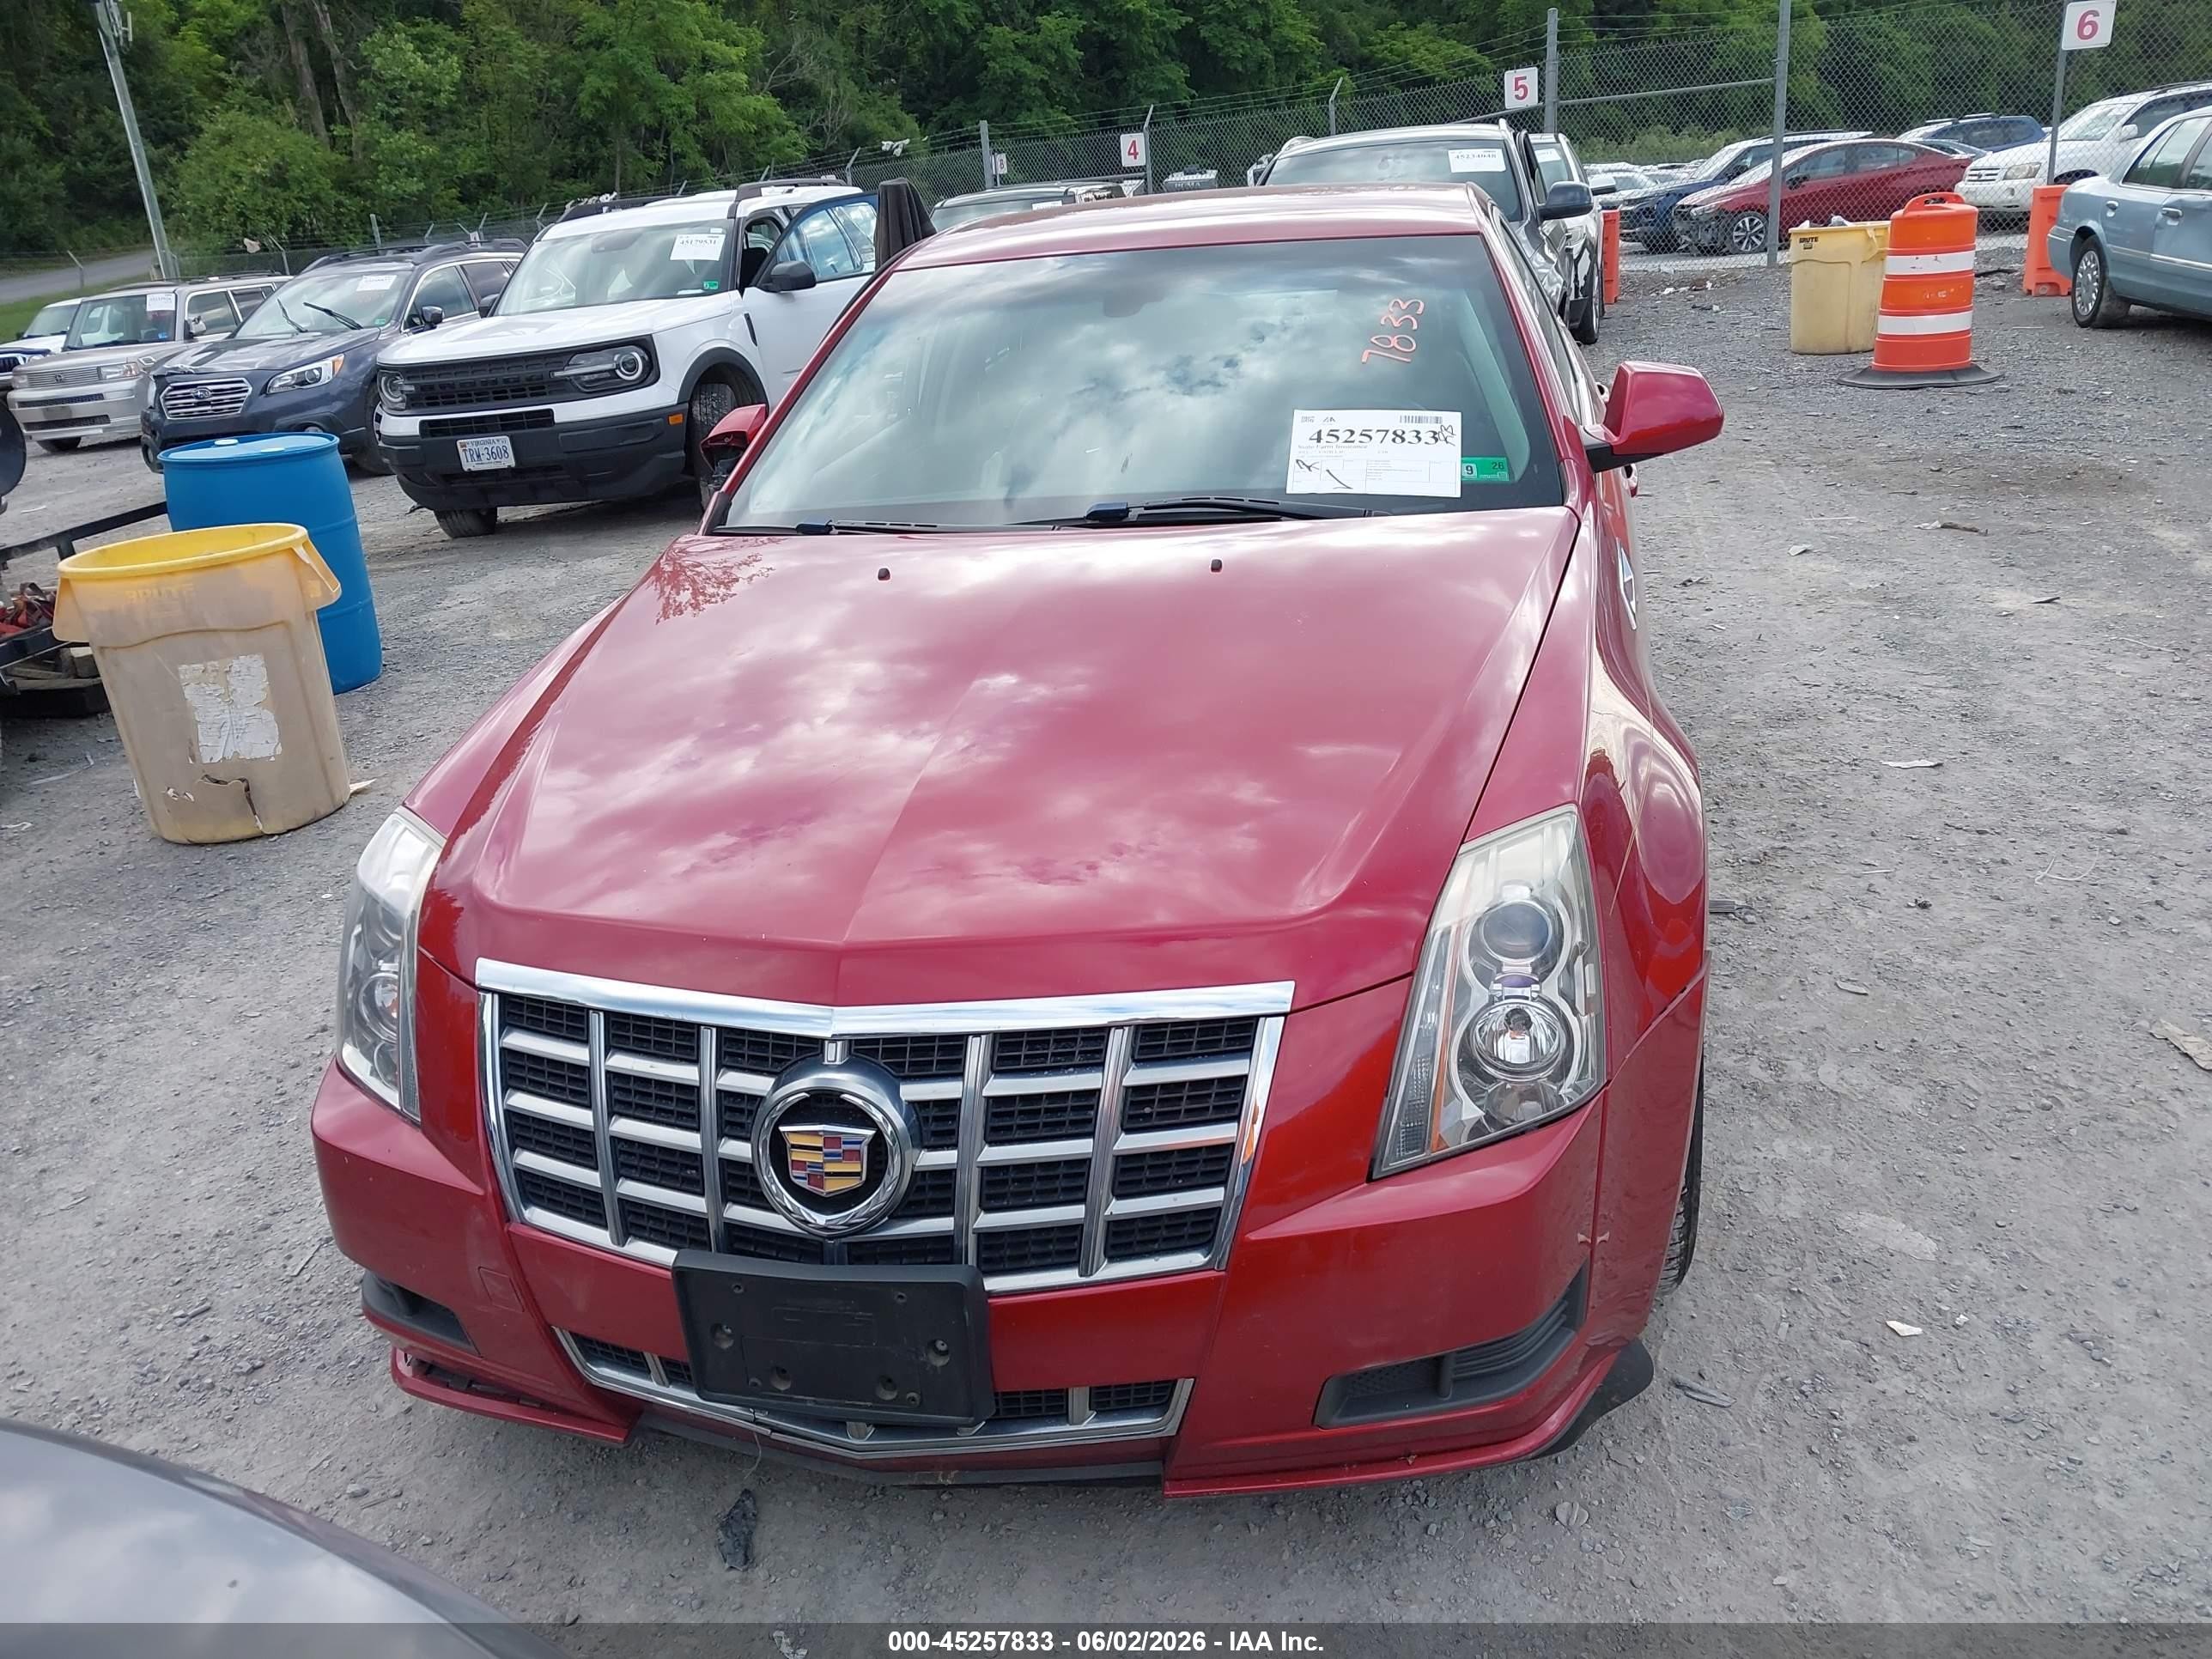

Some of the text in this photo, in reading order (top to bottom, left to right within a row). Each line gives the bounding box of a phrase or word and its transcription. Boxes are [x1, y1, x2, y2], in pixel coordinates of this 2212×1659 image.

[2077, 9, 2100, 40] 6
[1514, 76, 1528, 100] 5
[1127, 140, 1139, 160] 4
[1361, 298, 1425, 364] 7833
[1308, 428, 1439, 445] 45257833
[462, 445, 509, 463] TRM-3608
[1465, 465, 1474, 475] 9
